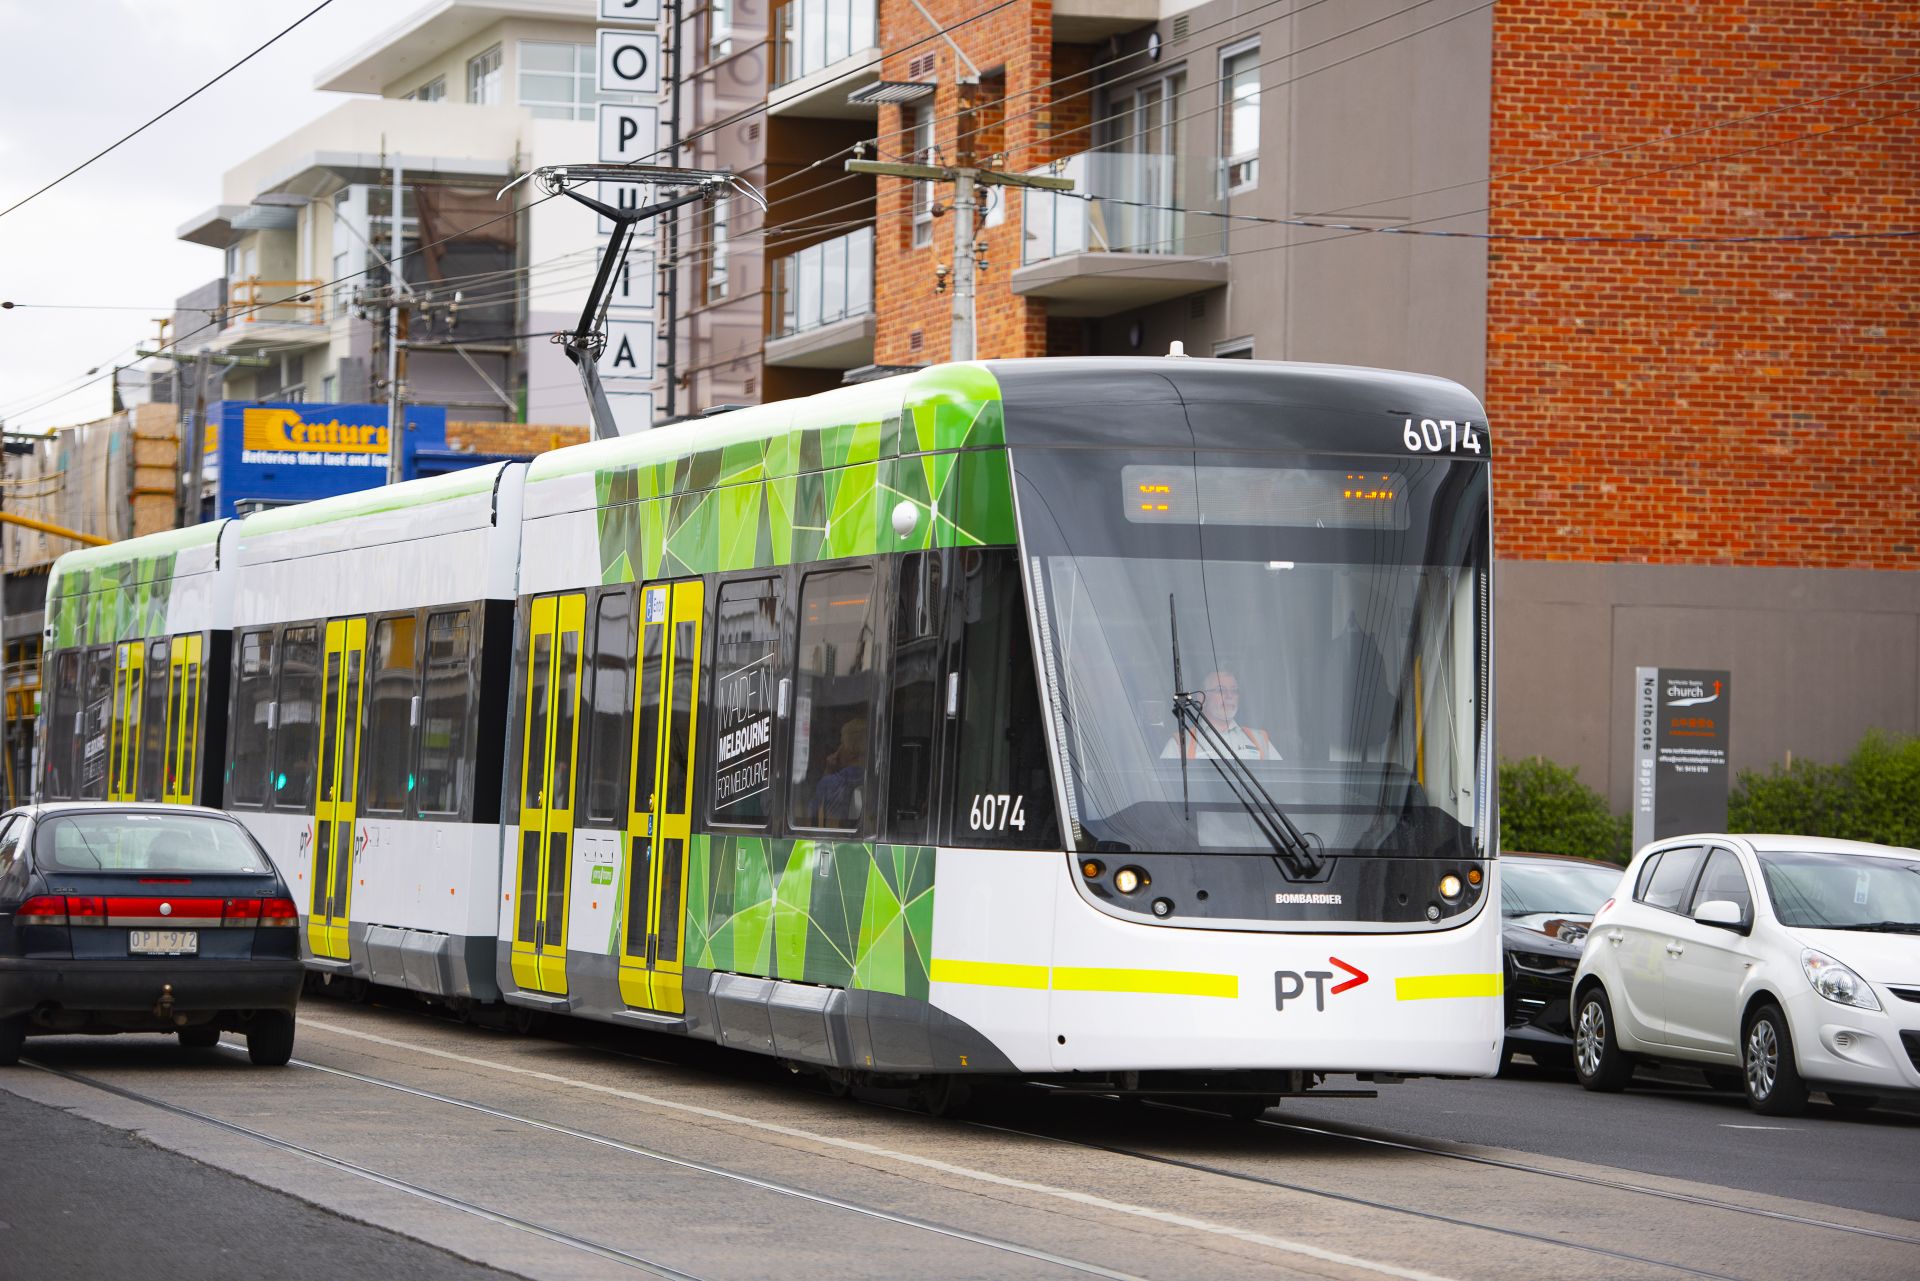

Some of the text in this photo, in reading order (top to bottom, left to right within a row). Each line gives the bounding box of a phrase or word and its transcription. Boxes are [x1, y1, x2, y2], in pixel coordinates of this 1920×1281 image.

[1403, 418, 1481, 454] 6074
[242, 450, 389, 467] Batteries that last and las
[720, 664, 772, 731] MADE IN
[1667, 685, 1704, 697] church
[719, 716, 770, 762] MELBOURNE
[1638, 677, 1655, 812] Northcote Baptist
[717, 759, 768, 800] FOR MELBOURNE
[970, 794, 1026, 831] 6074
[1275, 893, 1342, 905] BOMBARDIER
[170, 931, 196, 948] 972
